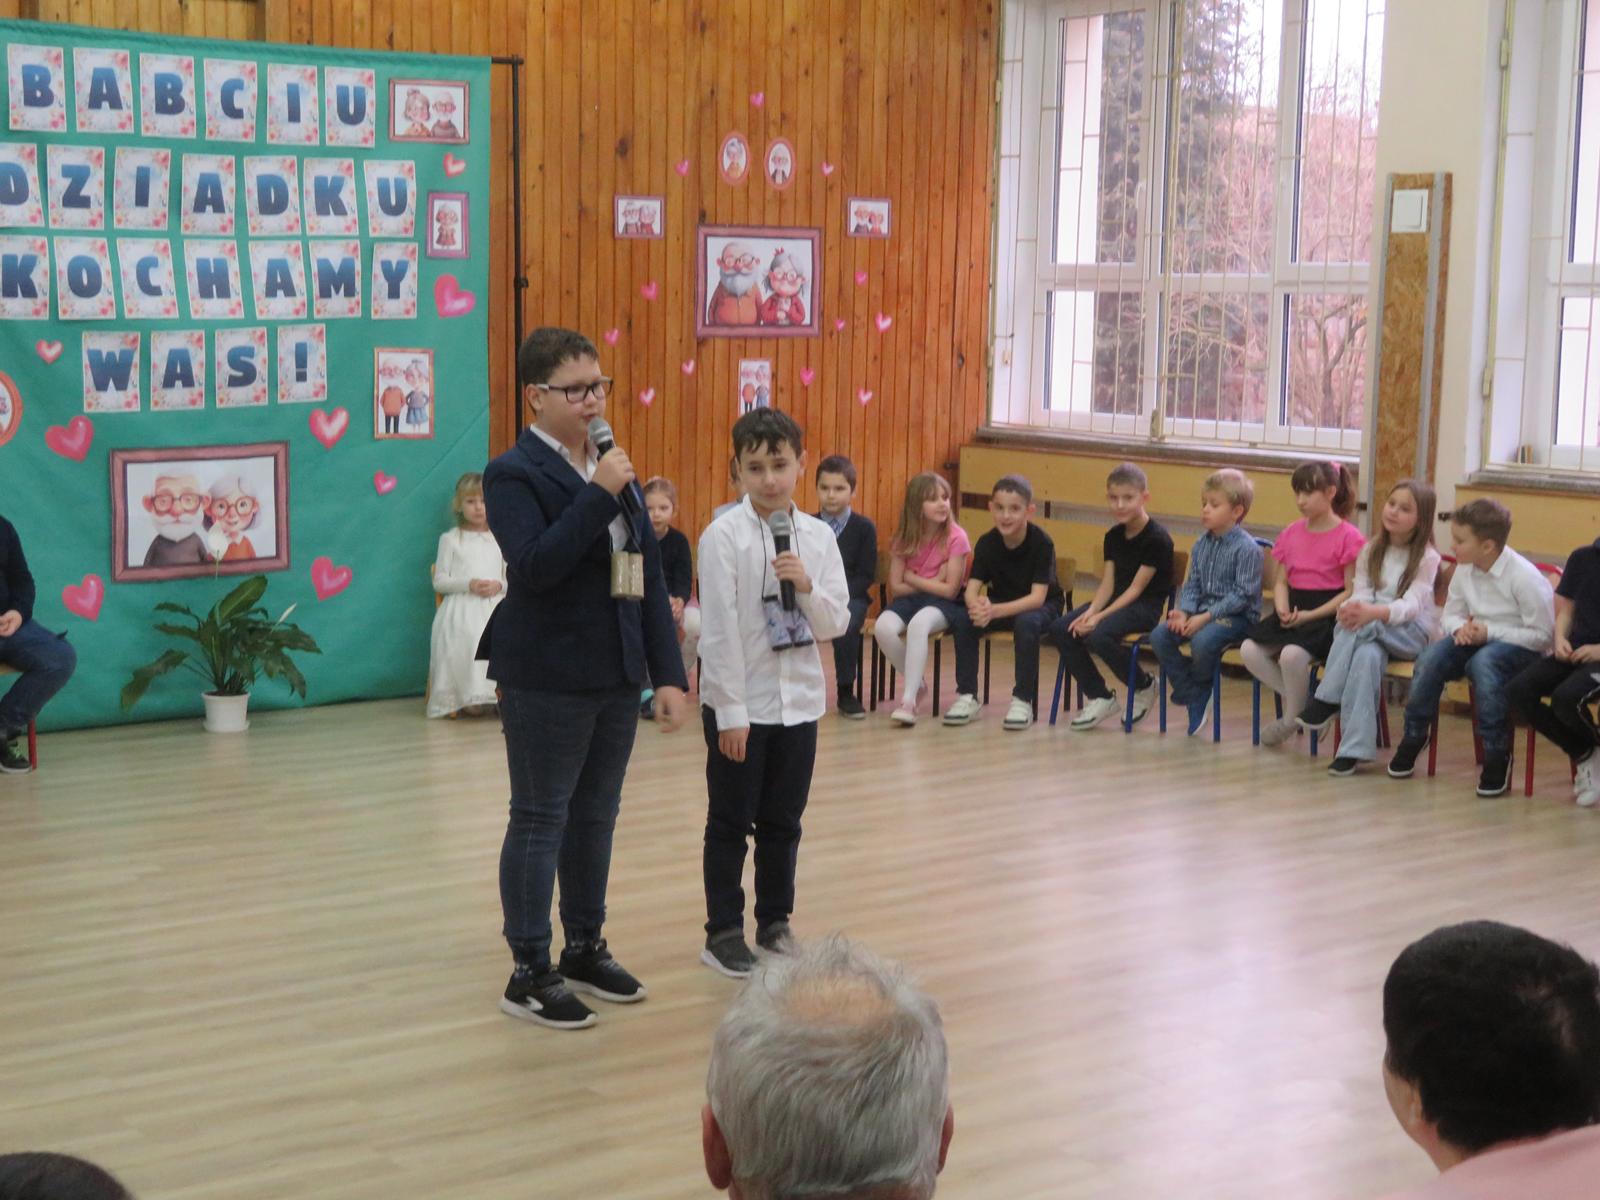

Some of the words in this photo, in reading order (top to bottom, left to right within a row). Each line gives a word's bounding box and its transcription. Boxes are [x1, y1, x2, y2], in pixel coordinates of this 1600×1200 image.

[21, 64, 367, 125] BABCIU
[0, 162, 408, 216] DZIADKU
[2, 254, 408, 299] KOCHAMY
[87, 342, 308, 391] WAS!
